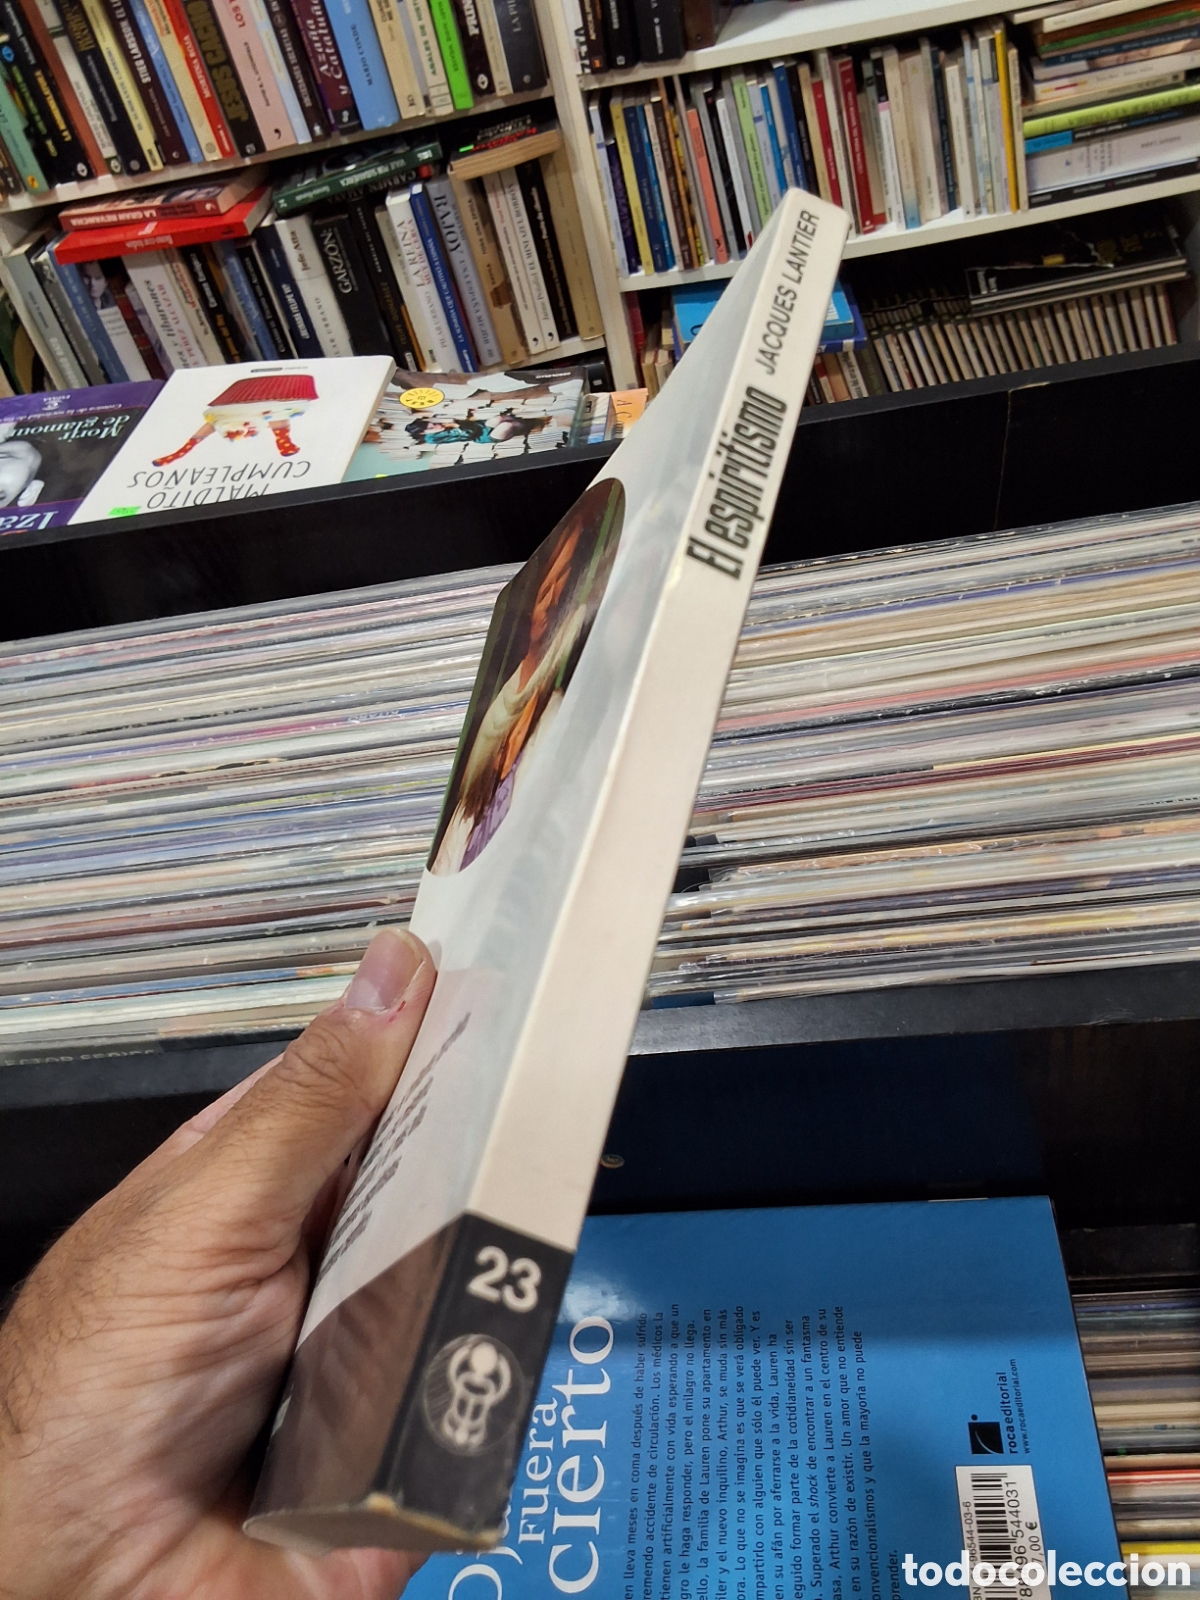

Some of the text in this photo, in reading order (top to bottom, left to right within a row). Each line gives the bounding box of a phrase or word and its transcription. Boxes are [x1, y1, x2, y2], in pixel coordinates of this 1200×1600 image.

[305, 17, 331, 76] Azaña
[348, 23, 373, 85] MARIO CONDE
[134, 58, 152, 83] STIEG
[190, 57, 211, 98] MORFINA
[70, 213, 116, 226] REVANCHA
[395, 219, 419, 266] REINA
[755, 209, 820, 373] JACQUES LANTIER
[11, 415, 130, 438] de glamour
[58, 424, 125, 443] Morir
[127, 461, 311, 490] CUMPLEAÑOS
[686, 386, 786, 579] El espiritismo
[146, 483, 269, 510] MALDITO
[466, 1245, 542, 1314] 23
[683, 1319, 697, 1348] llega.
[717, 1308, 727, 1328] más
[733, 1305, 745, 1350] obligado
[785, 1319, 793, 1334] ser
[699, 1324, 713, 1392] apartamento
[717, 1332, 727, 1348] sin
[752, 1335, 760, 1354] ver.
[783, 1338, 794, 1354] sin
[817, 1339, 829, 1374] centro
[850, 1330, 865, 1363] puede
[665, 1352, 680, 1407] esperando
[717, 1353, 727, 1381] muda
[733, 1353, 743, 1376] verá
[750, 1358, 763, 1391] puede
[682, 1369, 696, 1410] milagro
[784, 1358, 797, 1434] cotidianeidad
[855, 1385, 870, 1430] mayoría
[1009, 1357, 1030, 1454] www.rocaeditorial.com
[664, 1411, 676, 1435] vida
[701, 1413, 712, 1441] pone
[716, 1401, 728, 1440] Arthur,
[751, 1409, 762, 1433] sólo
[821, 1411, 833, 1450] Lauren
[832, 1305, 858, 1550] razón existir. amor entiende
[996, 1370, 1018, 1454] rocaeditorial
[623, 1312, 647, 1578] lleva meses coma después haber sufrido
[641, 1324, 663, 1599] remendo accidente circulación. Los médicos
[684, 1431, 694, 1455] pero
[734, 1437, 746, 1485] imagina
[766, 1350, 783, 1559] afán por aferrarse vida, Lauren
[799, 1315, 824, 1587] Superado shock encontrar fantasma
[698, 1445, 709, 1485] Lauren
[716, 1445, 729, 1503] inquilino,
[752, 1463, 765, 1508] alguien
[680, 1460, 694, 1521] responder,
[788, 1472, 801, 1503] parte
[824, 1466, 837, 1523] convierte
[661, 1465, 674, 1554] artificialmente
[697, 1509, 708, 1551] familia
[719, 1508, 727, 1545] nuevo
[789, 1508, 801, 1549] formar
[1005, 1479, 1027, 1546] 544031
[679, 1526, 692, 1556] haga
[827, 1528, 840, 1569] Arthur
[962, 1501, 981, 1584] -96544-03-6
[1024, 1520, 1046, 1574] 7,00 €
